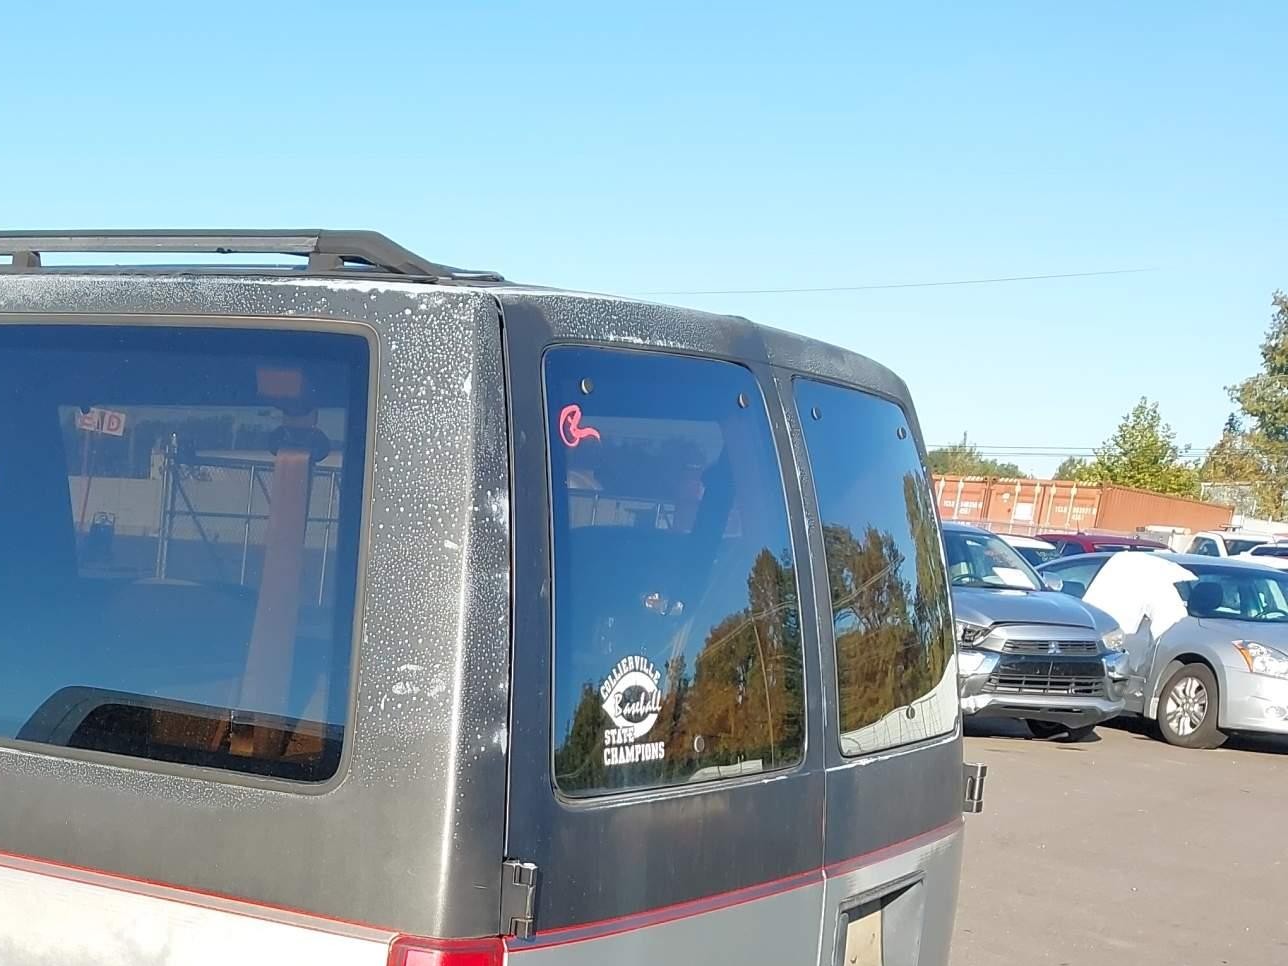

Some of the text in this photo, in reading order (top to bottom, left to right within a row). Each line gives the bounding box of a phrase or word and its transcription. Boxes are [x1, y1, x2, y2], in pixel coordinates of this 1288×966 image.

[600, 656, 661, 700] COLLIERVILLE
[614, 690, 662, 718] Baseball
[604, 726, 635, 745] STATE
[603, 741, 665, 766] CHAMPIONS
